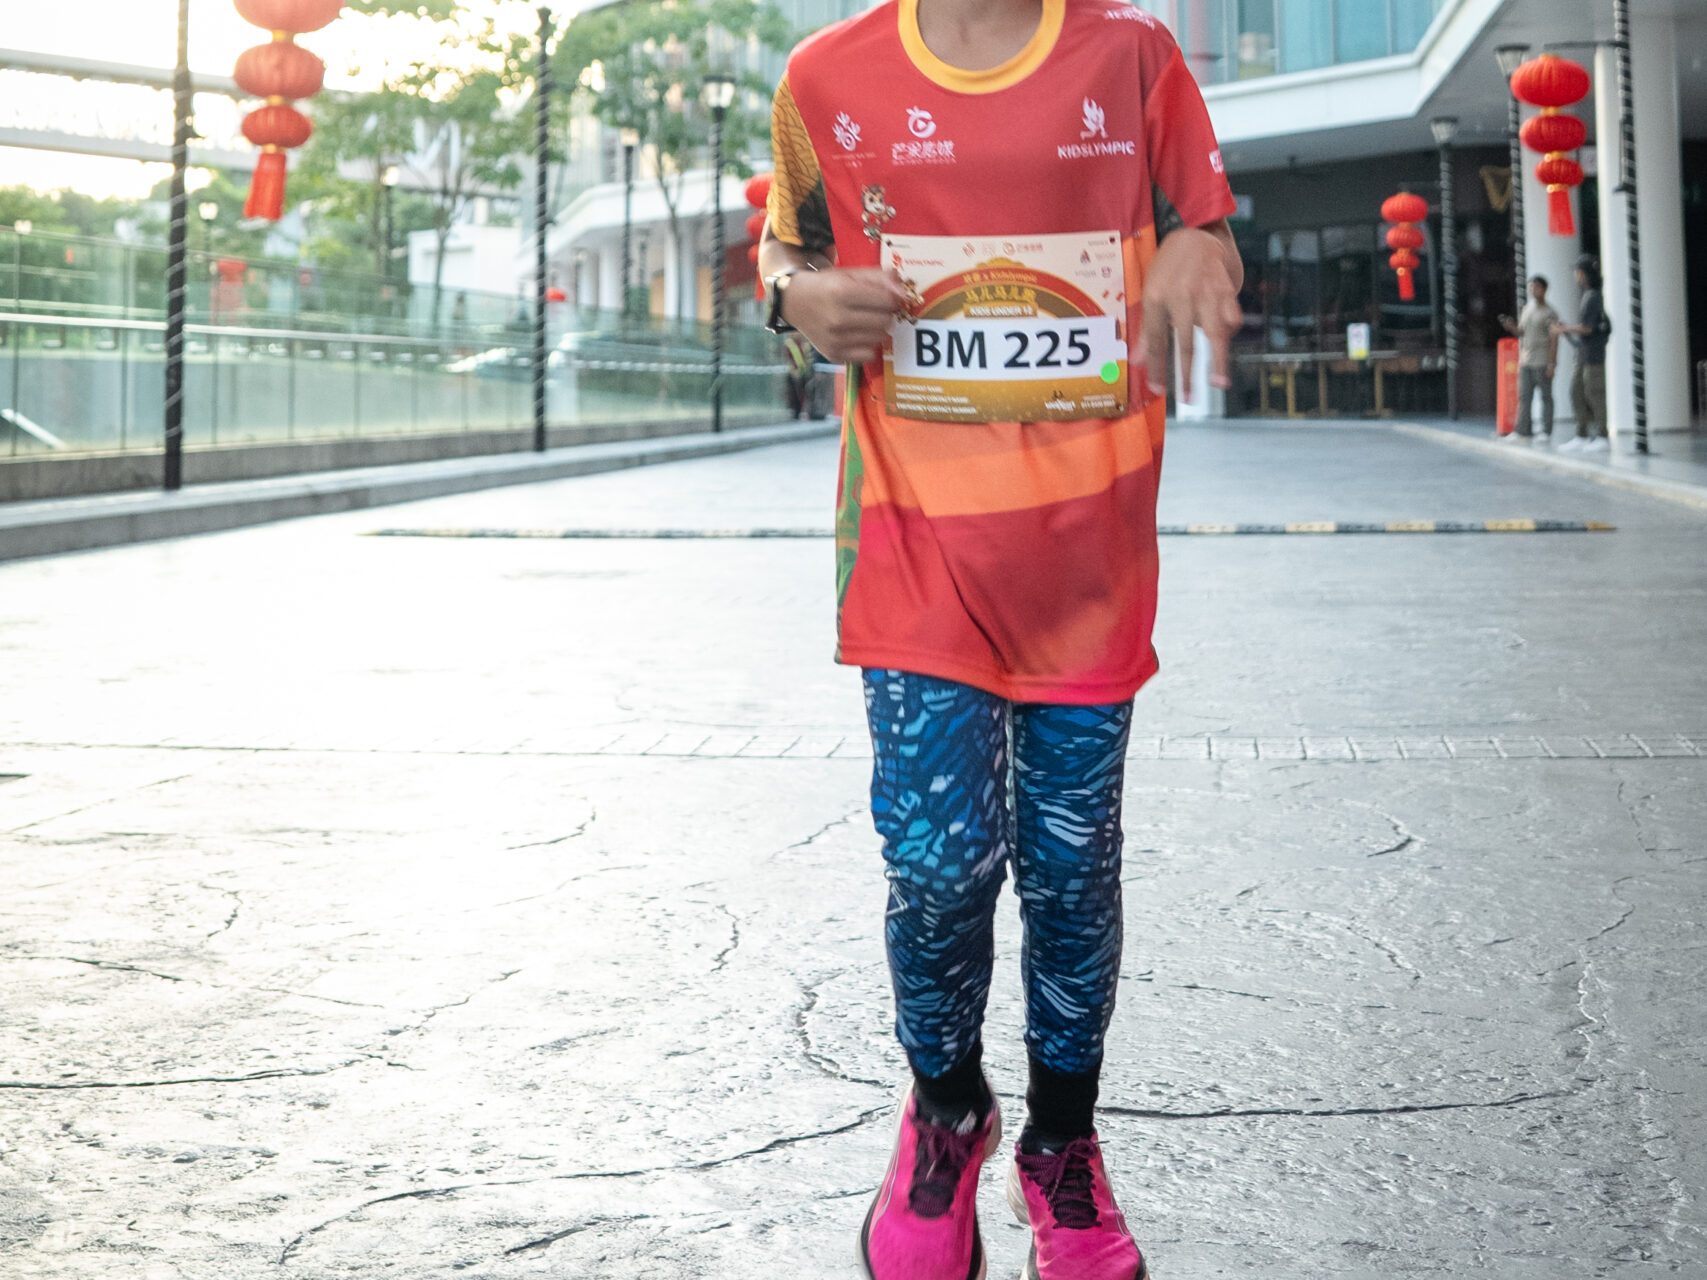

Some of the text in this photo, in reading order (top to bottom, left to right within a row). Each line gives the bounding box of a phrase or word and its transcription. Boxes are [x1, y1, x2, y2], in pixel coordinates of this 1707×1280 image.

[1057, 140, 1136, 159] KIDSLYMPIC
[915, 328, 1091, 369] BM 225
